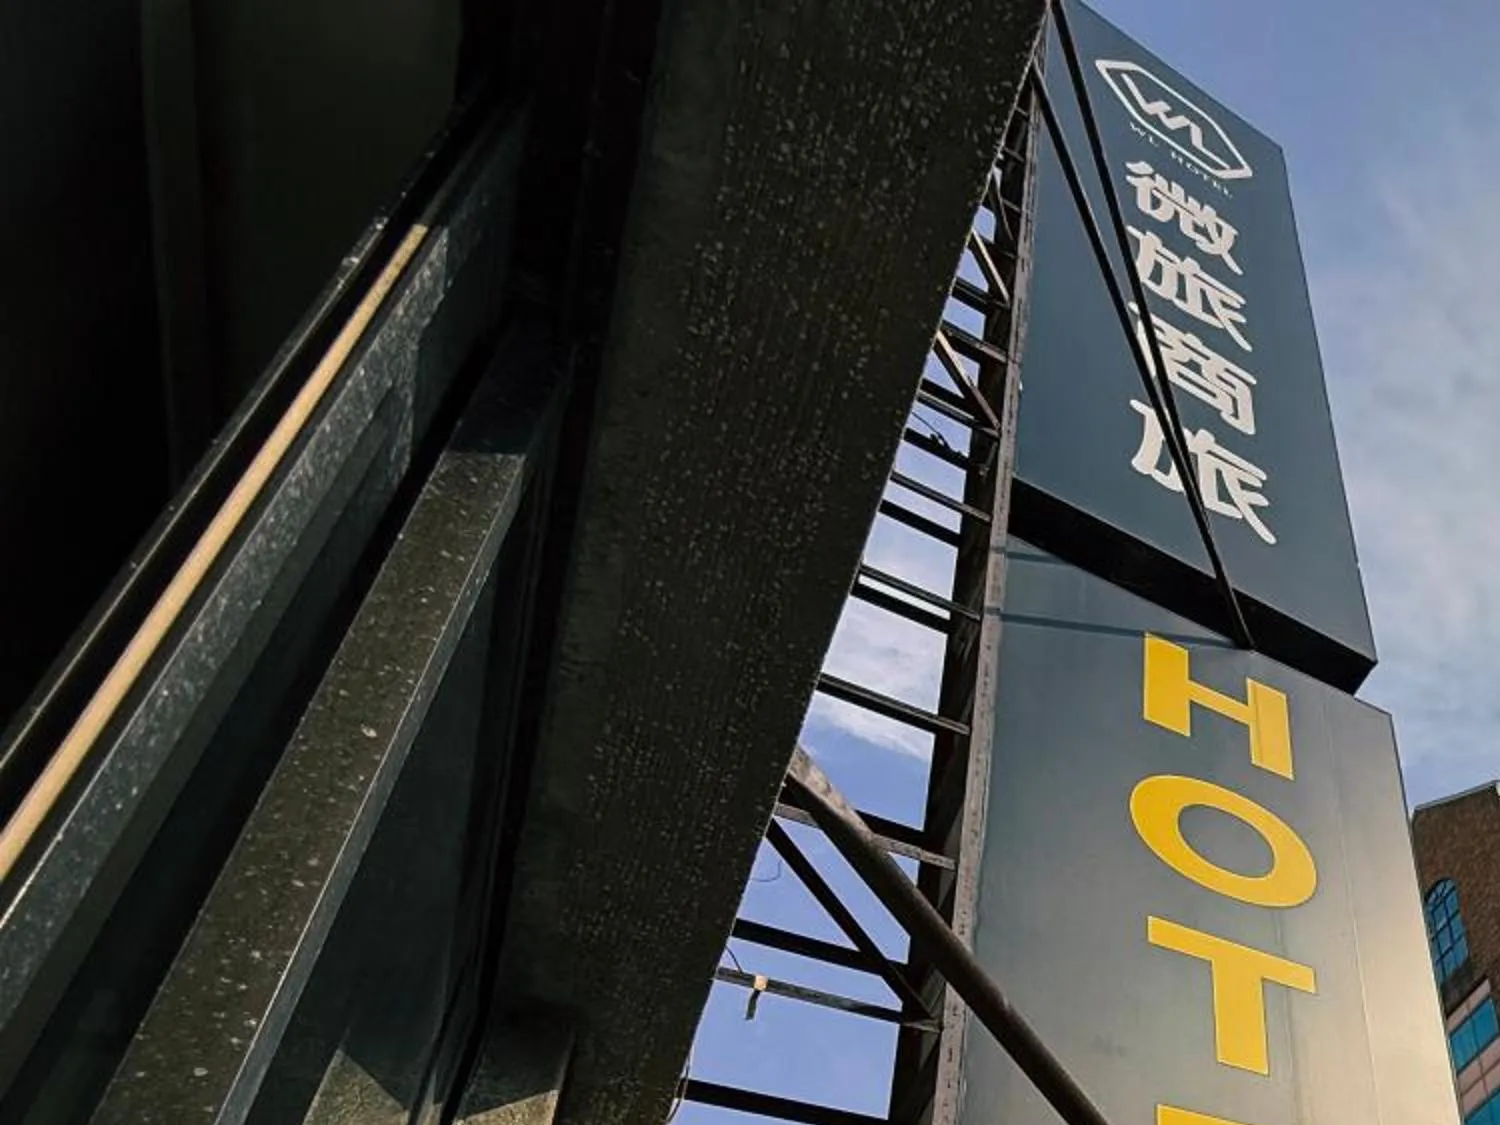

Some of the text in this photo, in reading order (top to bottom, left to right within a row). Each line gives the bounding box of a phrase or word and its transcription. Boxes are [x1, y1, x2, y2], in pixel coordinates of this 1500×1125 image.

[1170, 150, 1234, 199] HOTEL
[1125, 160, 1278, 546] 微旅商旅
